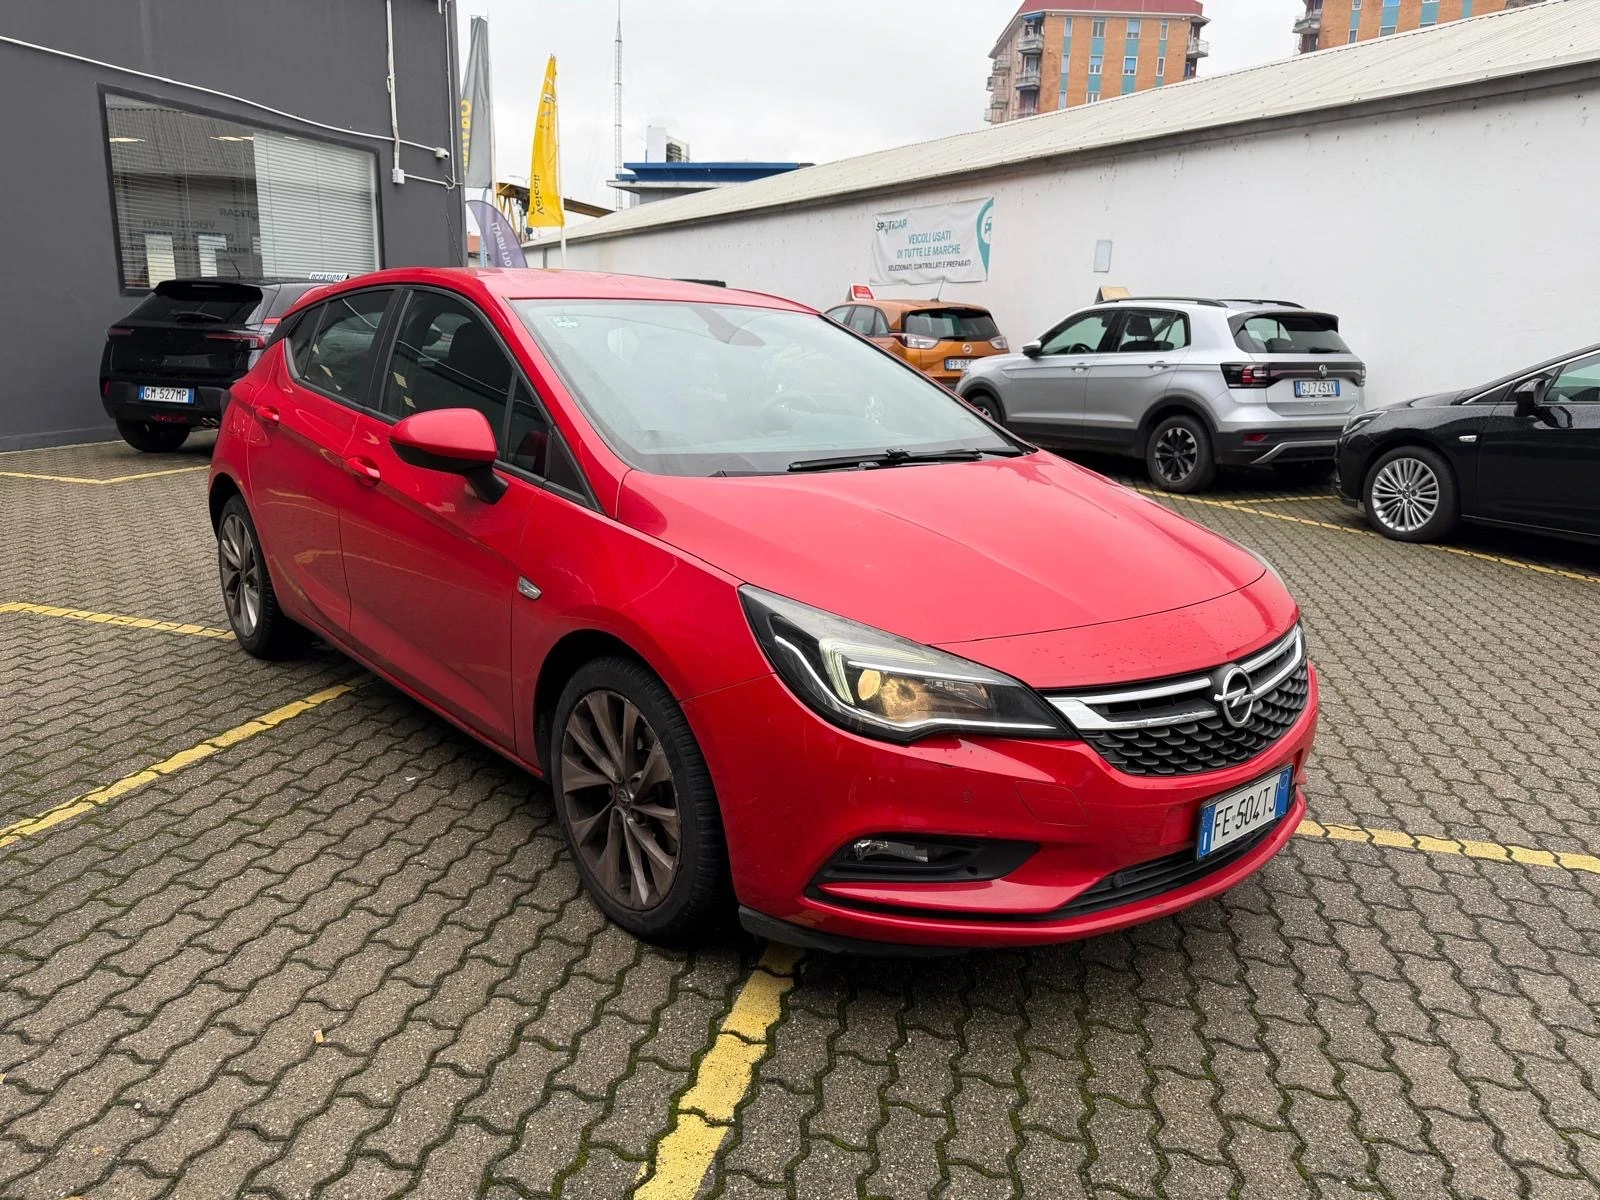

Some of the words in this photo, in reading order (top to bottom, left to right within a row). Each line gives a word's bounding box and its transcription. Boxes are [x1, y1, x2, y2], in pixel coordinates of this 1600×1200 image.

[876, 219, 907, 235] SPOTICAR
[908, 232, 932, 244] VEICOLI
[932, 230, 951, 242] USATI
[896, 249, 903, 259] DI
[903, 247, 923, 259] TUTTE
[923, 246, 932, 257] LE
[932, 244, 960, 255] MARCHE
[946, 259, 971, 268] PREPARATI
[159, 388, 187, 400] 527MP
[1213, 804, 1233, 841] FE
[1235, 782, 1279, 830] 504TJ
